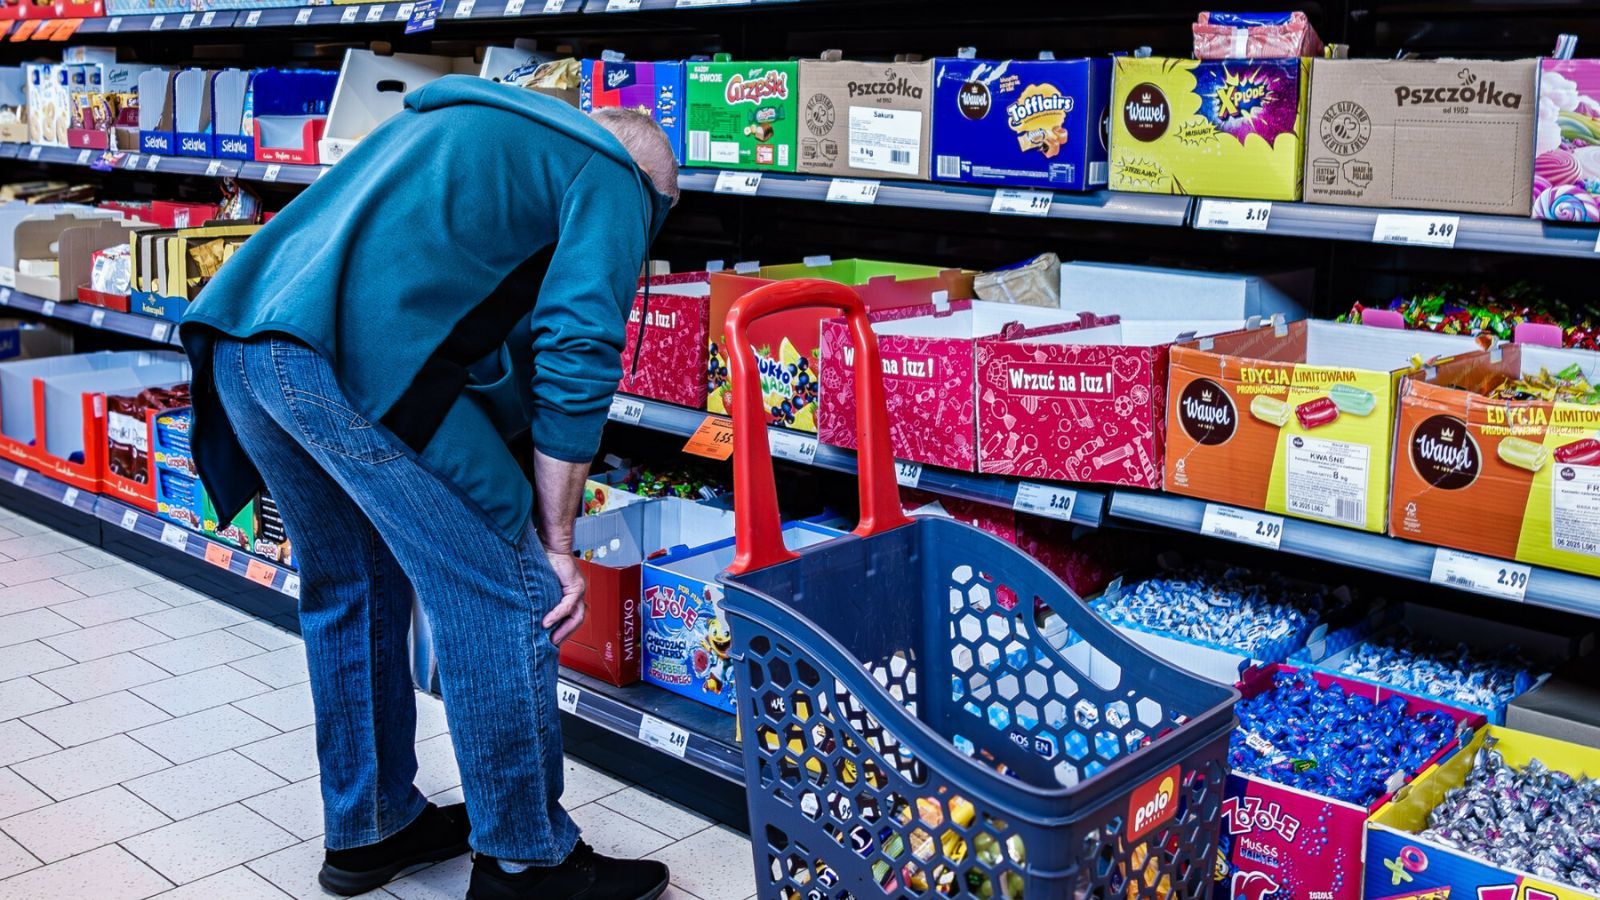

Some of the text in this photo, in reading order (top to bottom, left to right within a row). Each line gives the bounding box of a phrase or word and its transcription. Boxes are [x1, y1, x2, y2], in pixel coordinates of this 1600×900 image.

[699, 73, 722, 82] SWOJE
[1008, 94, 1074, 122] Tofflairs
[1216, 85, 1265, 118] X-PLODE
[873, 111, 894, 119] Sakura
[1126, 101, 1166, 122] Wawel
[145, 136, 168, 149] Sielanka
[182, 138, 207, 152] Sielanka
[222, 139, 247, 154] Sielanka
[1030, 197, 1050, 210] 3.19
[1246, 209, 1269, 221] 3.19
[1427, 223, 1453, 236] 3.49
[882, 358, 899, 375] na
[1009, 368, 1055, 390] Wrzuć
[1058, 375, 1076, 391] na
[1240, 367, 1356, 386] EDYCJA LIMITOWANA
[1183, 396, 1231, 425] Wawel
[1486, 405, 1548, 425] EDYCJA
[900, 464, 917, 478] 3.50
[1050, 494, 1071, 510] 3.20
[1256, 521, 1279, 538] 2.99
[1497, 568, 1527, 588] 2.99
[624, 599, 634, 661] MIESZKO
[562, 691, 576, 704] 2.40
[669, 731, 685, 747] 2.49
[1134, 792, 1168, 832] polo
[1240, 836, 1279, 858] MUSSS
